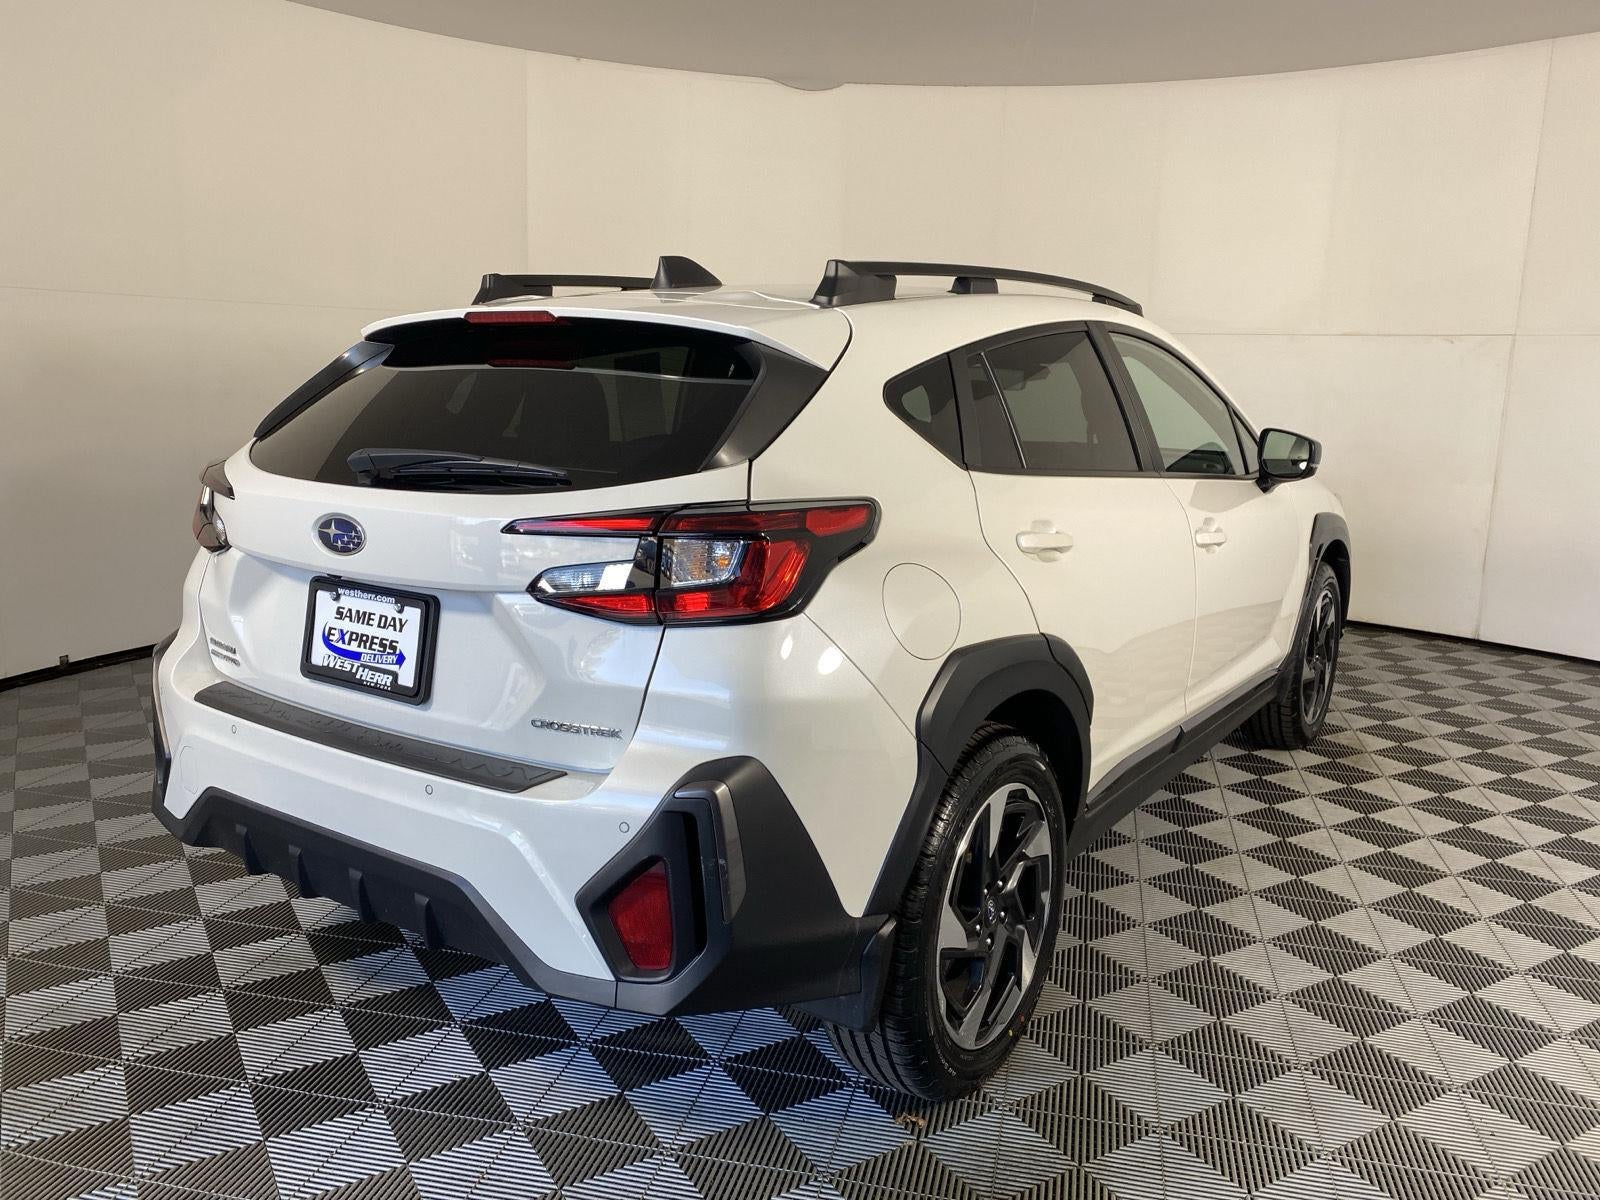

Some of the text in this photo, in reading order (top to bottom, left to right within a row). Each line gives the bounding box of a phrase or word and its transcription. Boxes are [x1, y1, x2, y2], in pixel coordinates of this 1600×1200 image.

[338, 587, 395, 604] westherr.com
[334, 606, 408, 633] SAME DAY
[327, 626, 399, 654] EXPRESS
[322, 654, 393, 686] WEST HERR
[361, 653, 398, 664] DELIVERY
[531, 719, 623, 740] CROSSTREK
